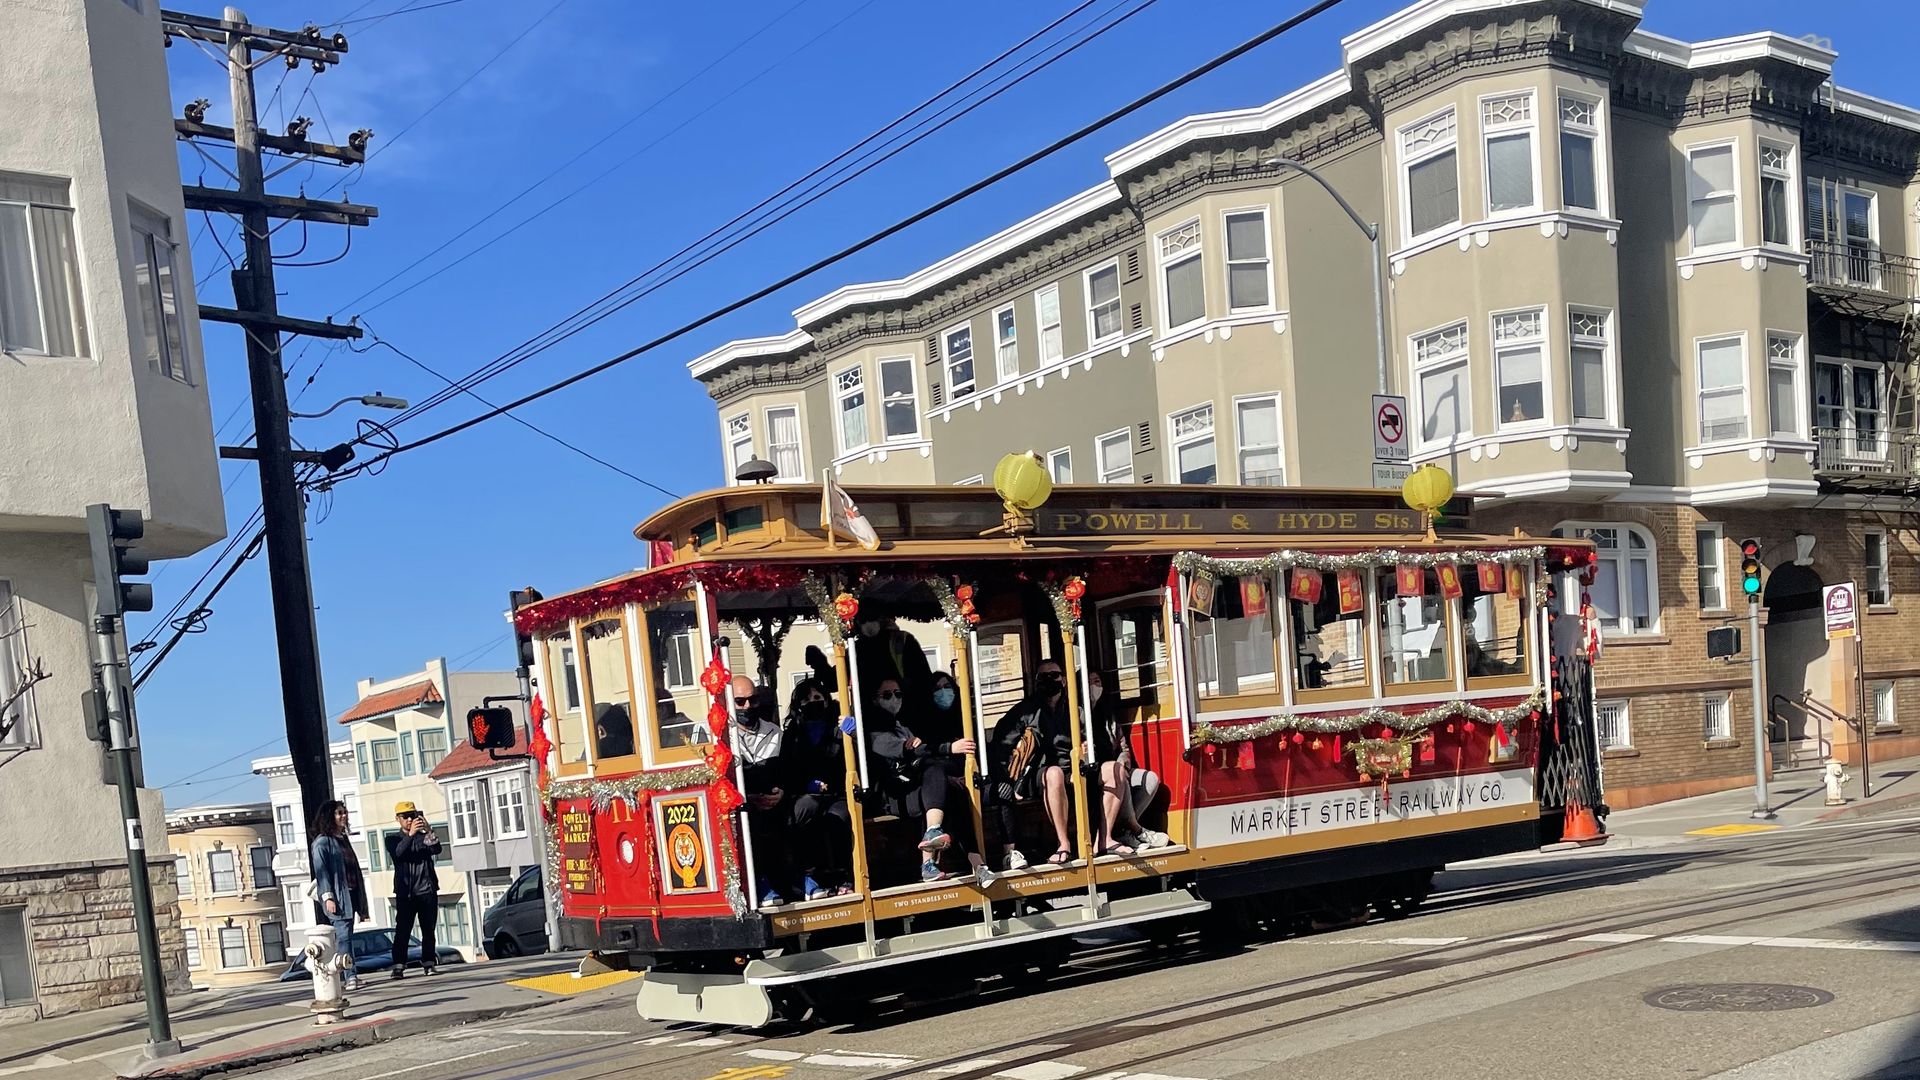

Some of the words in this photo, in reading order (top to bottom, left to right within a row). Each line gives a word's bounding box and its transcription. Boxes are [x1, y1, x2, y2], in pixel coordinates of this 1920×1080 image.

[1055, 513, 1203, 531] POWELL
[1231, 513, 1251, 530] &
[1278, 513, 1357, 529] HYDE
[1374, 513, 1414, 529] Sts.
[1197, 568, 1213, 581] 2022
[668, 805, 695, 824] 2022
[1231, 807, 1311, 834] MARKET
[1320, 796, 1392, 824] STREET
[1400, 787, 1475, 812] RAILWAY
[1480, 783, 1505, 802] CO.
[563, 813, 587, 825] POWELL
[570, 824, 582, 832] AND
[564, 832, 590, 843] MARKET
[1127, 861, 1152, 871] STANDEES
[1154, 859, 1168, 867] ONLY
[1022, 878, 1050, 888] STANDEES
[1051, 875, 1066, 883] ONLY
[894, 900, 909, 908] TWO
[910, 896, 941, 906] STANDEES
[942, 892, 959, 900] ONLY
[781, 918, 797, 927] TWO
[799, 913, 832, 924] STANDEES
[834, 910, 851, 919] ONLY
